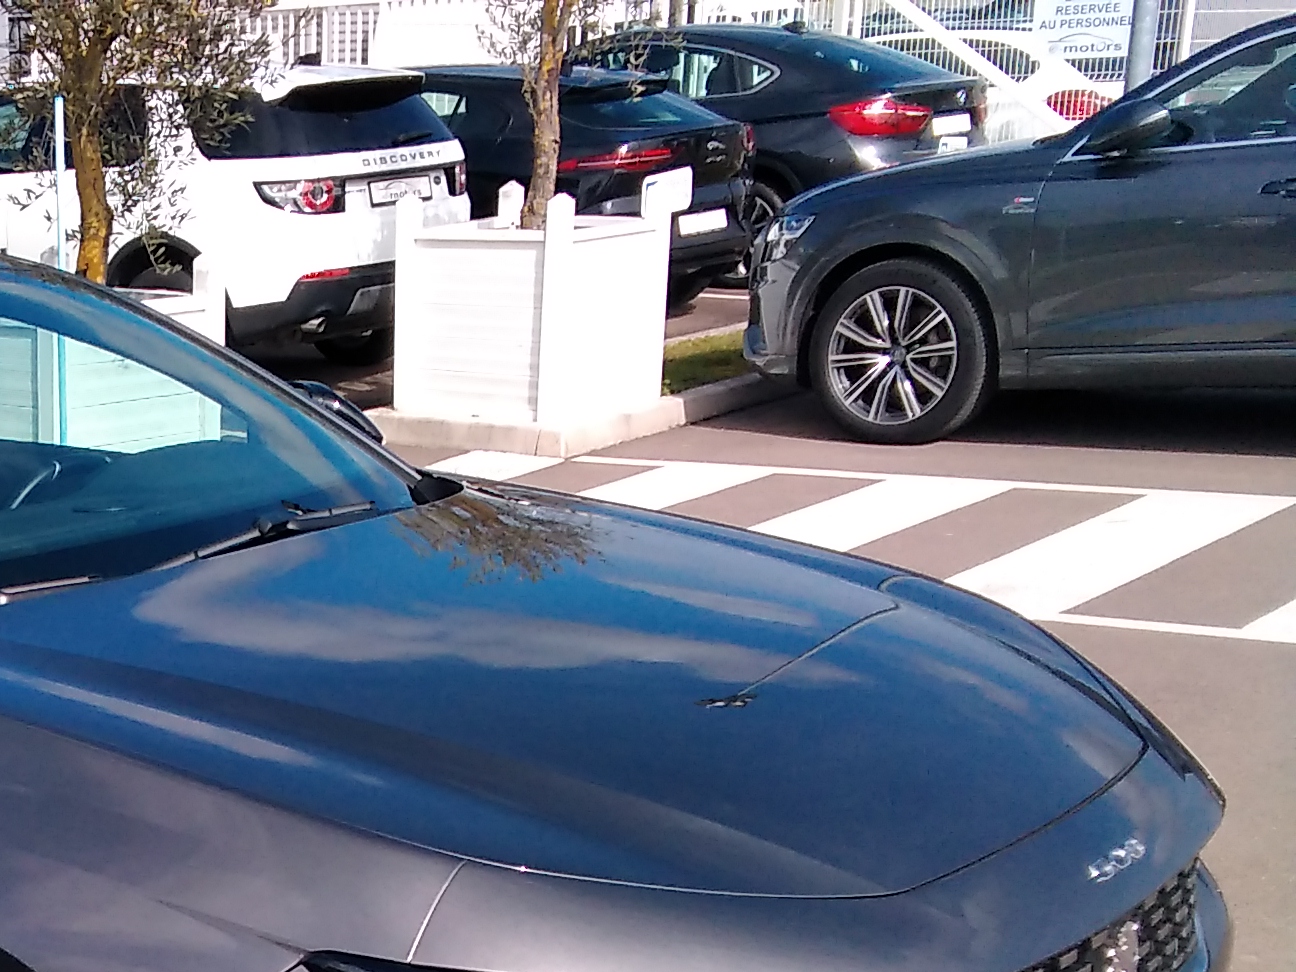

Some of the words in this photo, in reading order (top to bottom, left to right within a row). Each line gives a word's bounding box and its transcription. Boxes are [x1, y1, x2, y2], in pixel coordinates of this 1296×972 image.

[1039, 20, 1056, 30] AU
[1059, 16, 1133, 29] PERSONNEL
[362, 150, 440, 167] DISCOVERY
